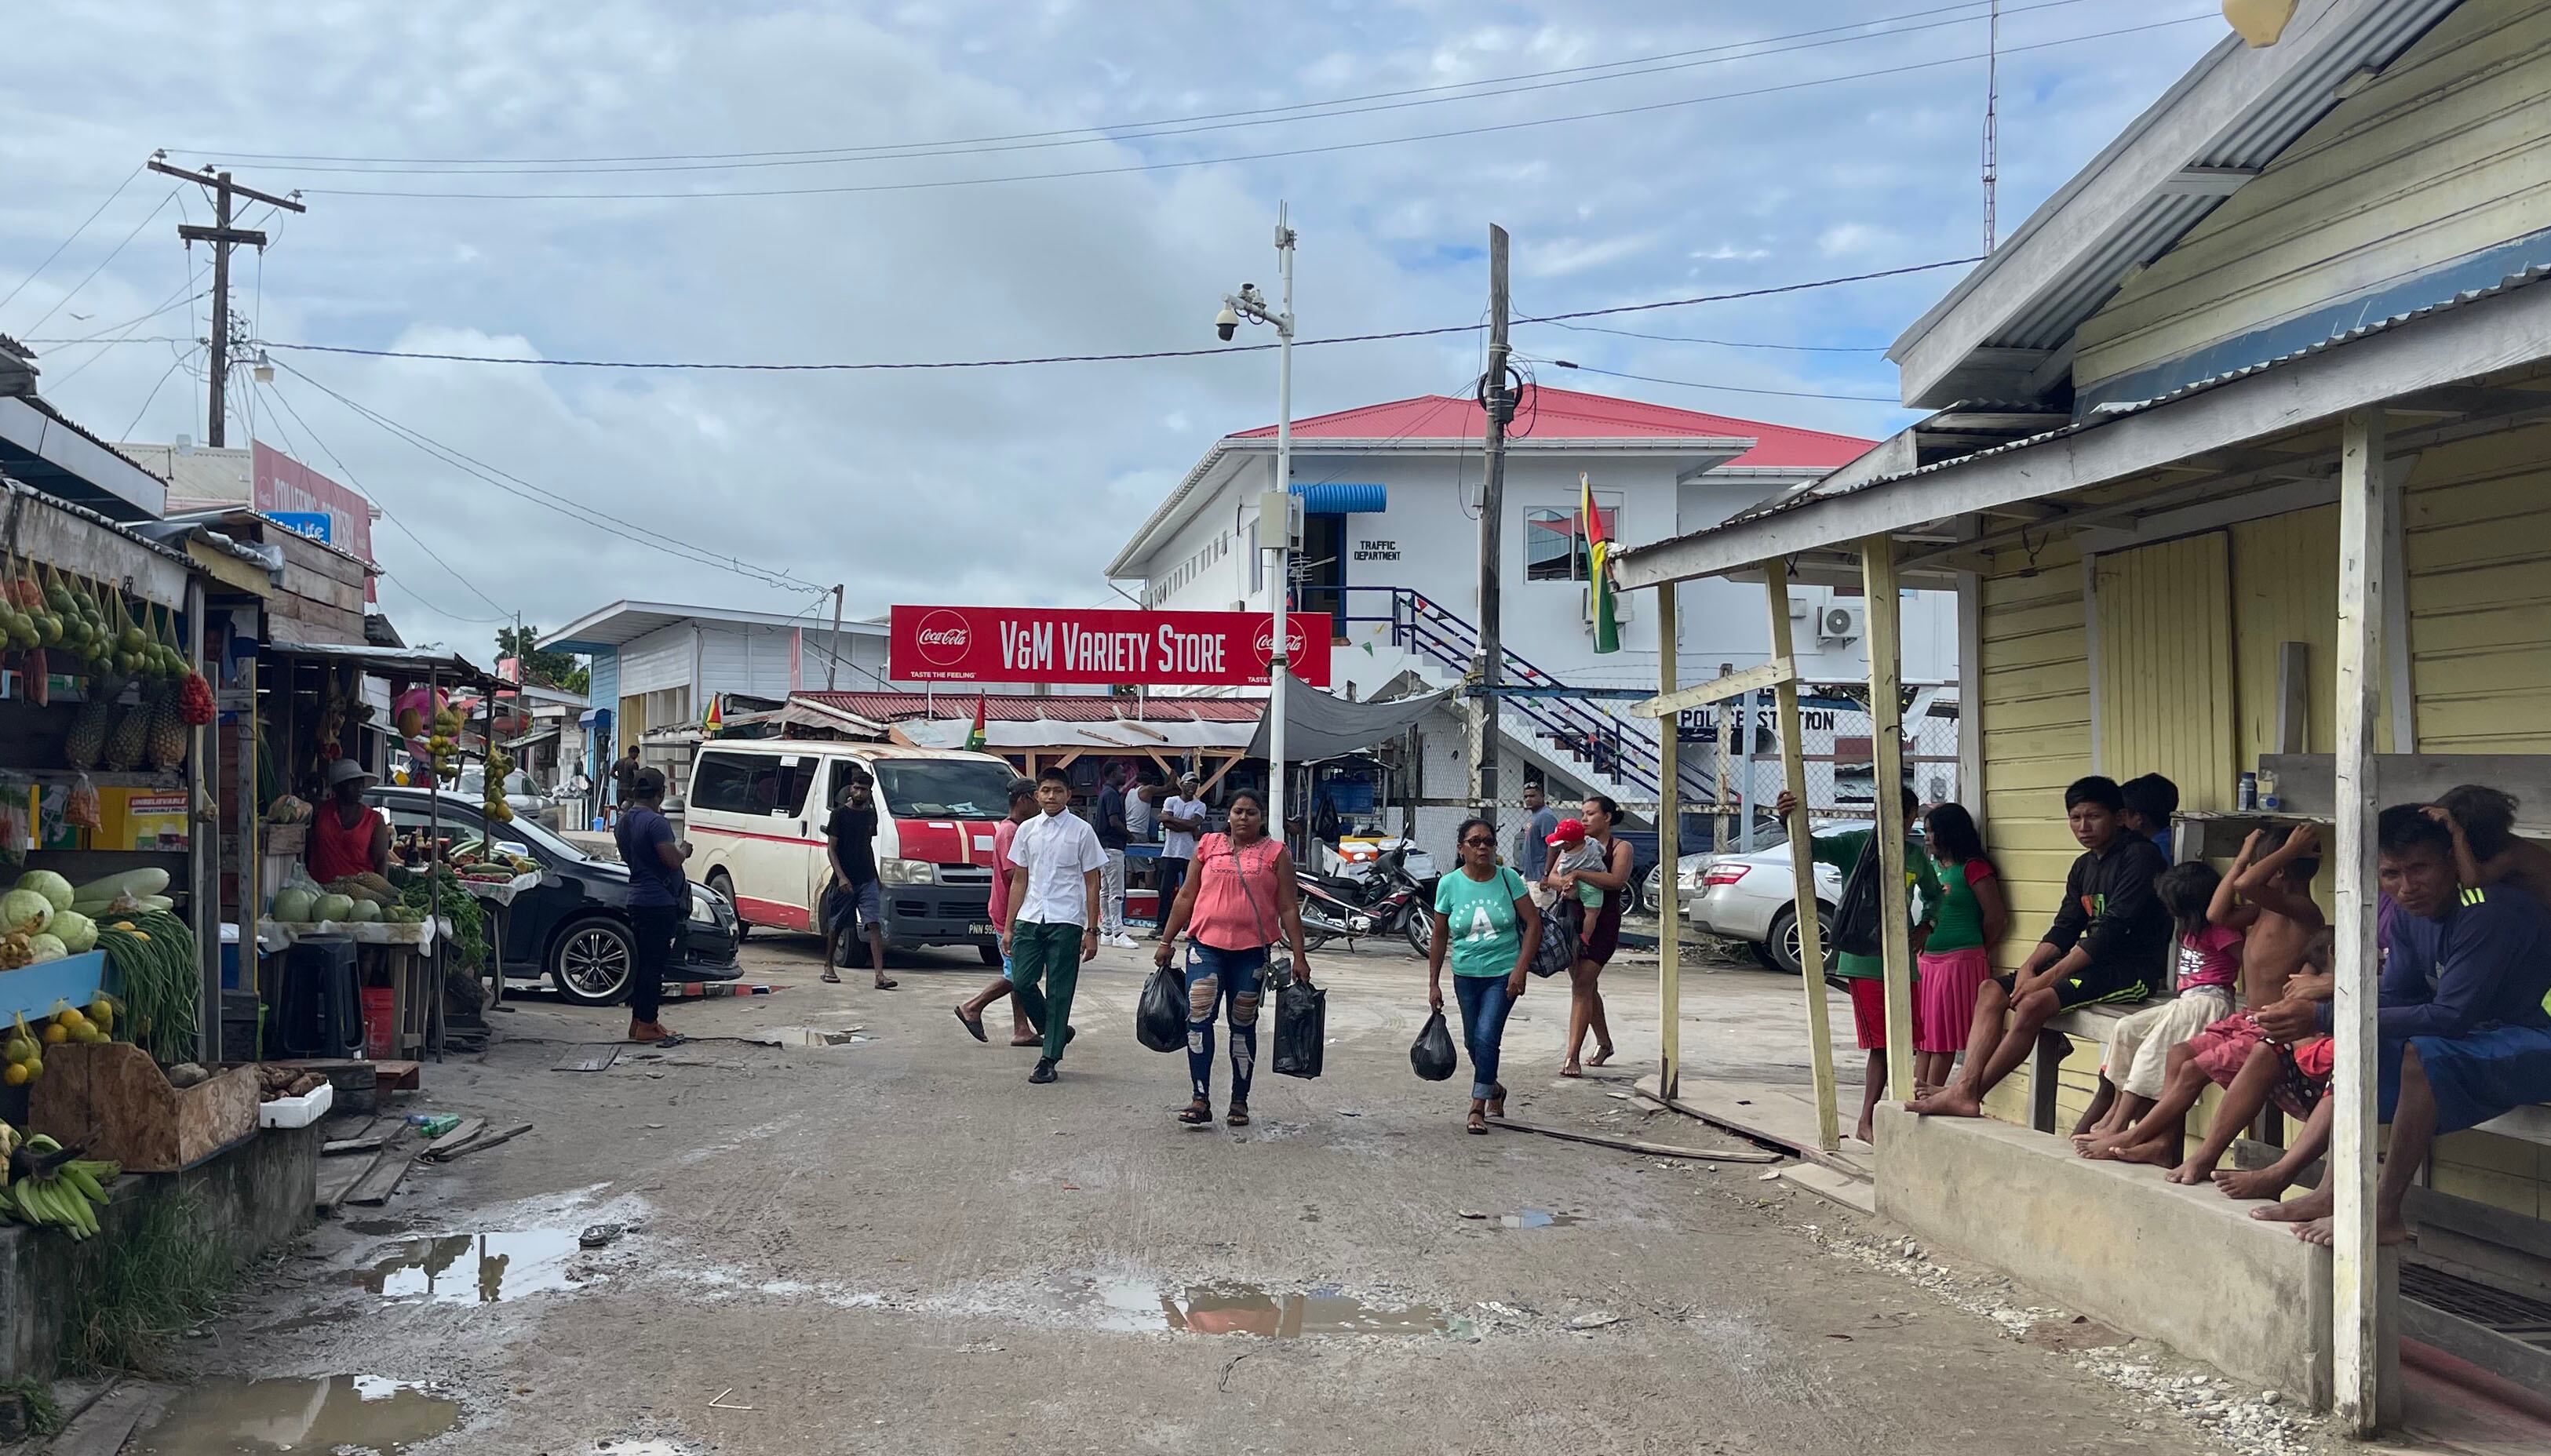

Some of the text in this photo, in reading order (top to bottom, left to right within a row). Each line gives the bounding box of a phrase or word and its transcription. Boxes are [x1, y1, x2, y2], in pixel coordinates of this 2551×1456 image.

[1360, 541, 1396, 550] TRAFFIC
[1354, 551, 1401, 561] DEPARTMENT
[919, 628, 968, 645] Coca-Cola
[1000, 621, 1226, 673] V&M VARIETY STORE
[1681, 710, 1835, 730] POLE STTION
[968, 924, 984, 934] PNN
[1465, 906, 1498, 941] A
